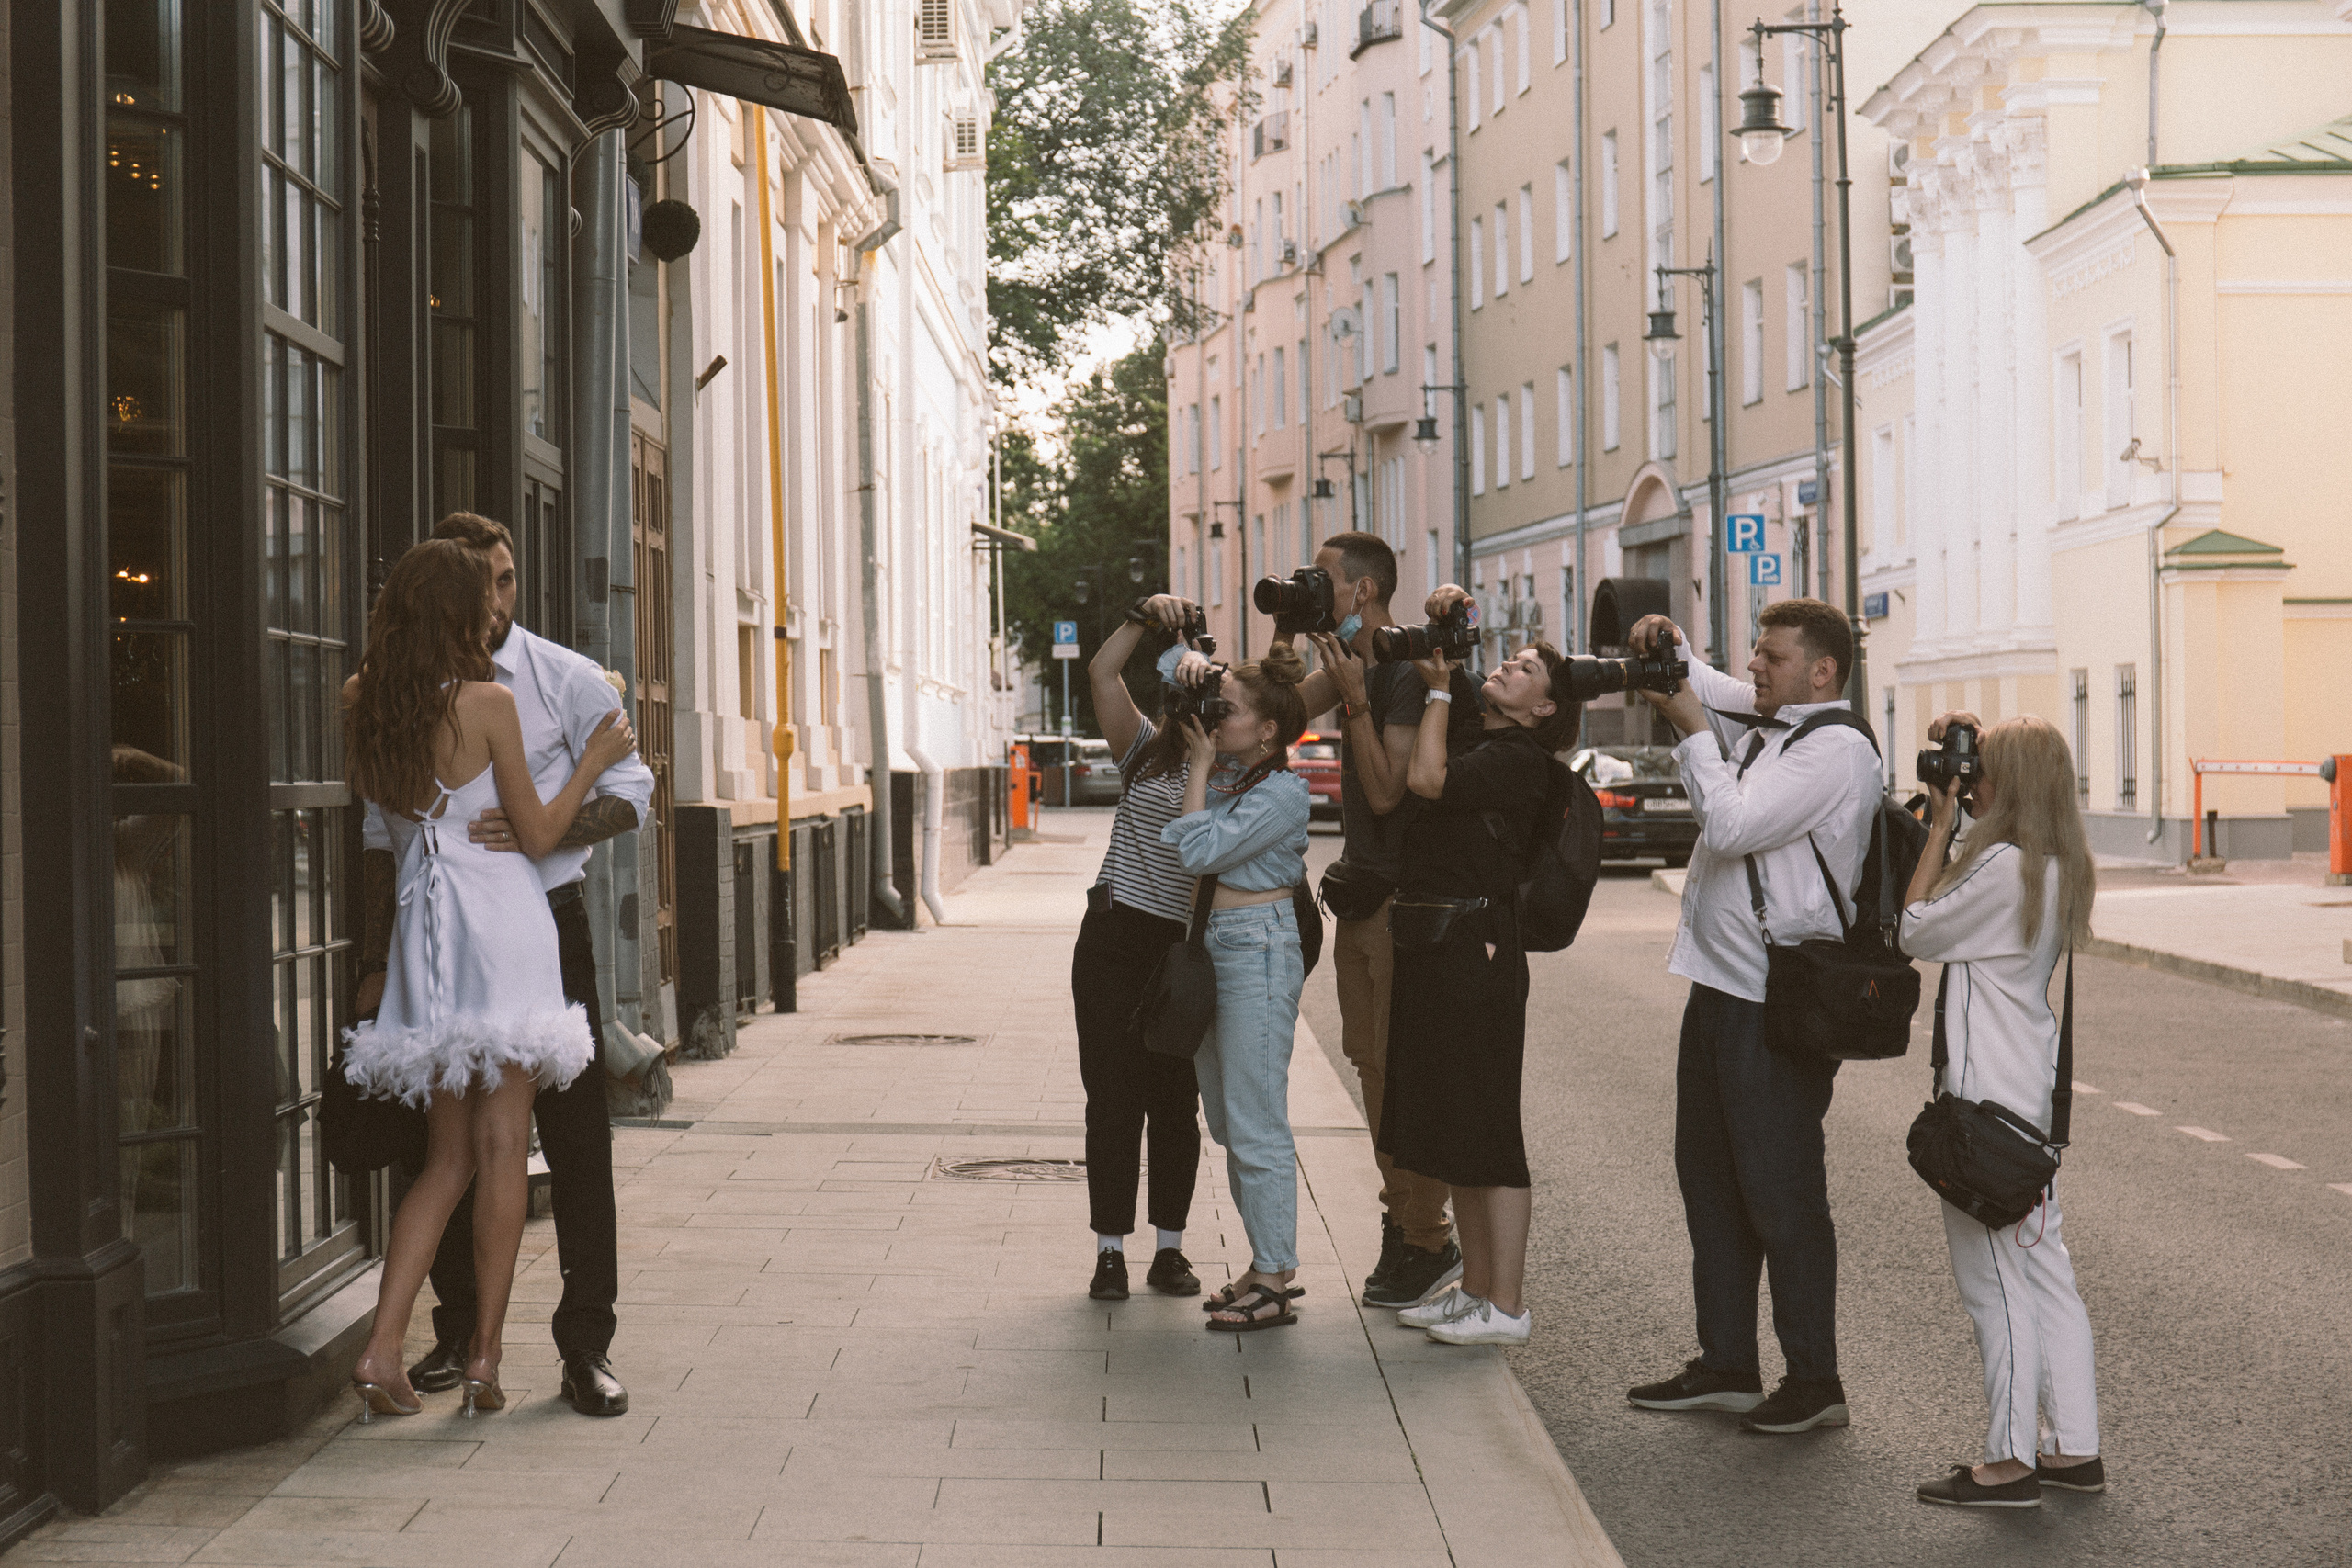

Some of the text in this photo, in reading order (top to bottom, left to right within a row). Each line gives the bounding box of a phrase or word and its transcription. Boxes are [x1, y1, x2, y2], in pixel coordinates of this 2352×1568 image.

[1736, 517, 1758, 550] P
[1758, 556, 1776, 583] P
[1059, 624, 1073, 641] P
